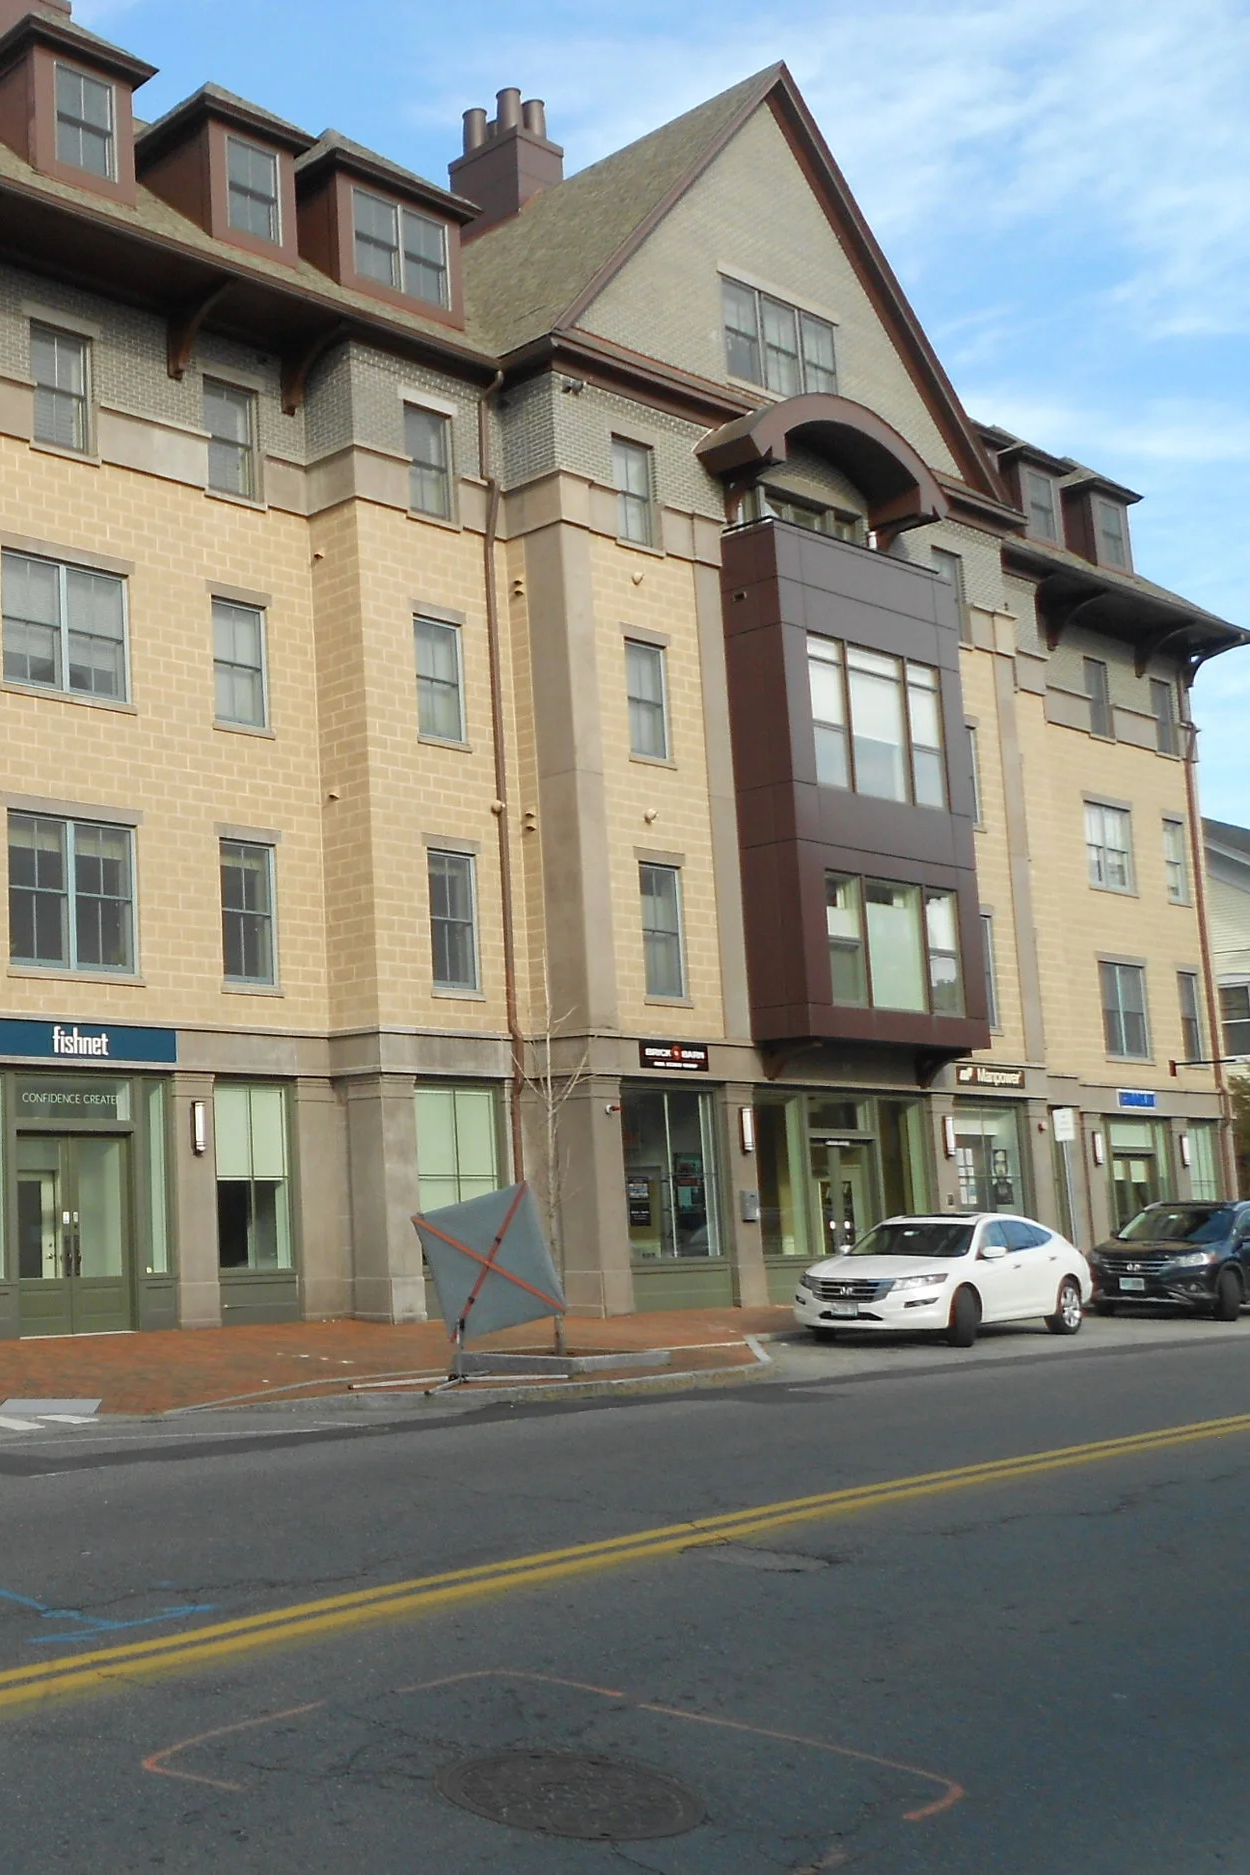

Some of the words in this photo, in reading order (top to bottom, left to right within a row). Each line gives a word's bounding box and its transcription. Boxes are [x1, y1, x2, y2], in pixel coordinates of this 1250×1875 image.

[52, 1025, 109, 1055] fishnet
[977, 1067, 1021, 1086] Manpower
[22, 1092, 81, 1105] CONFIDENCE
